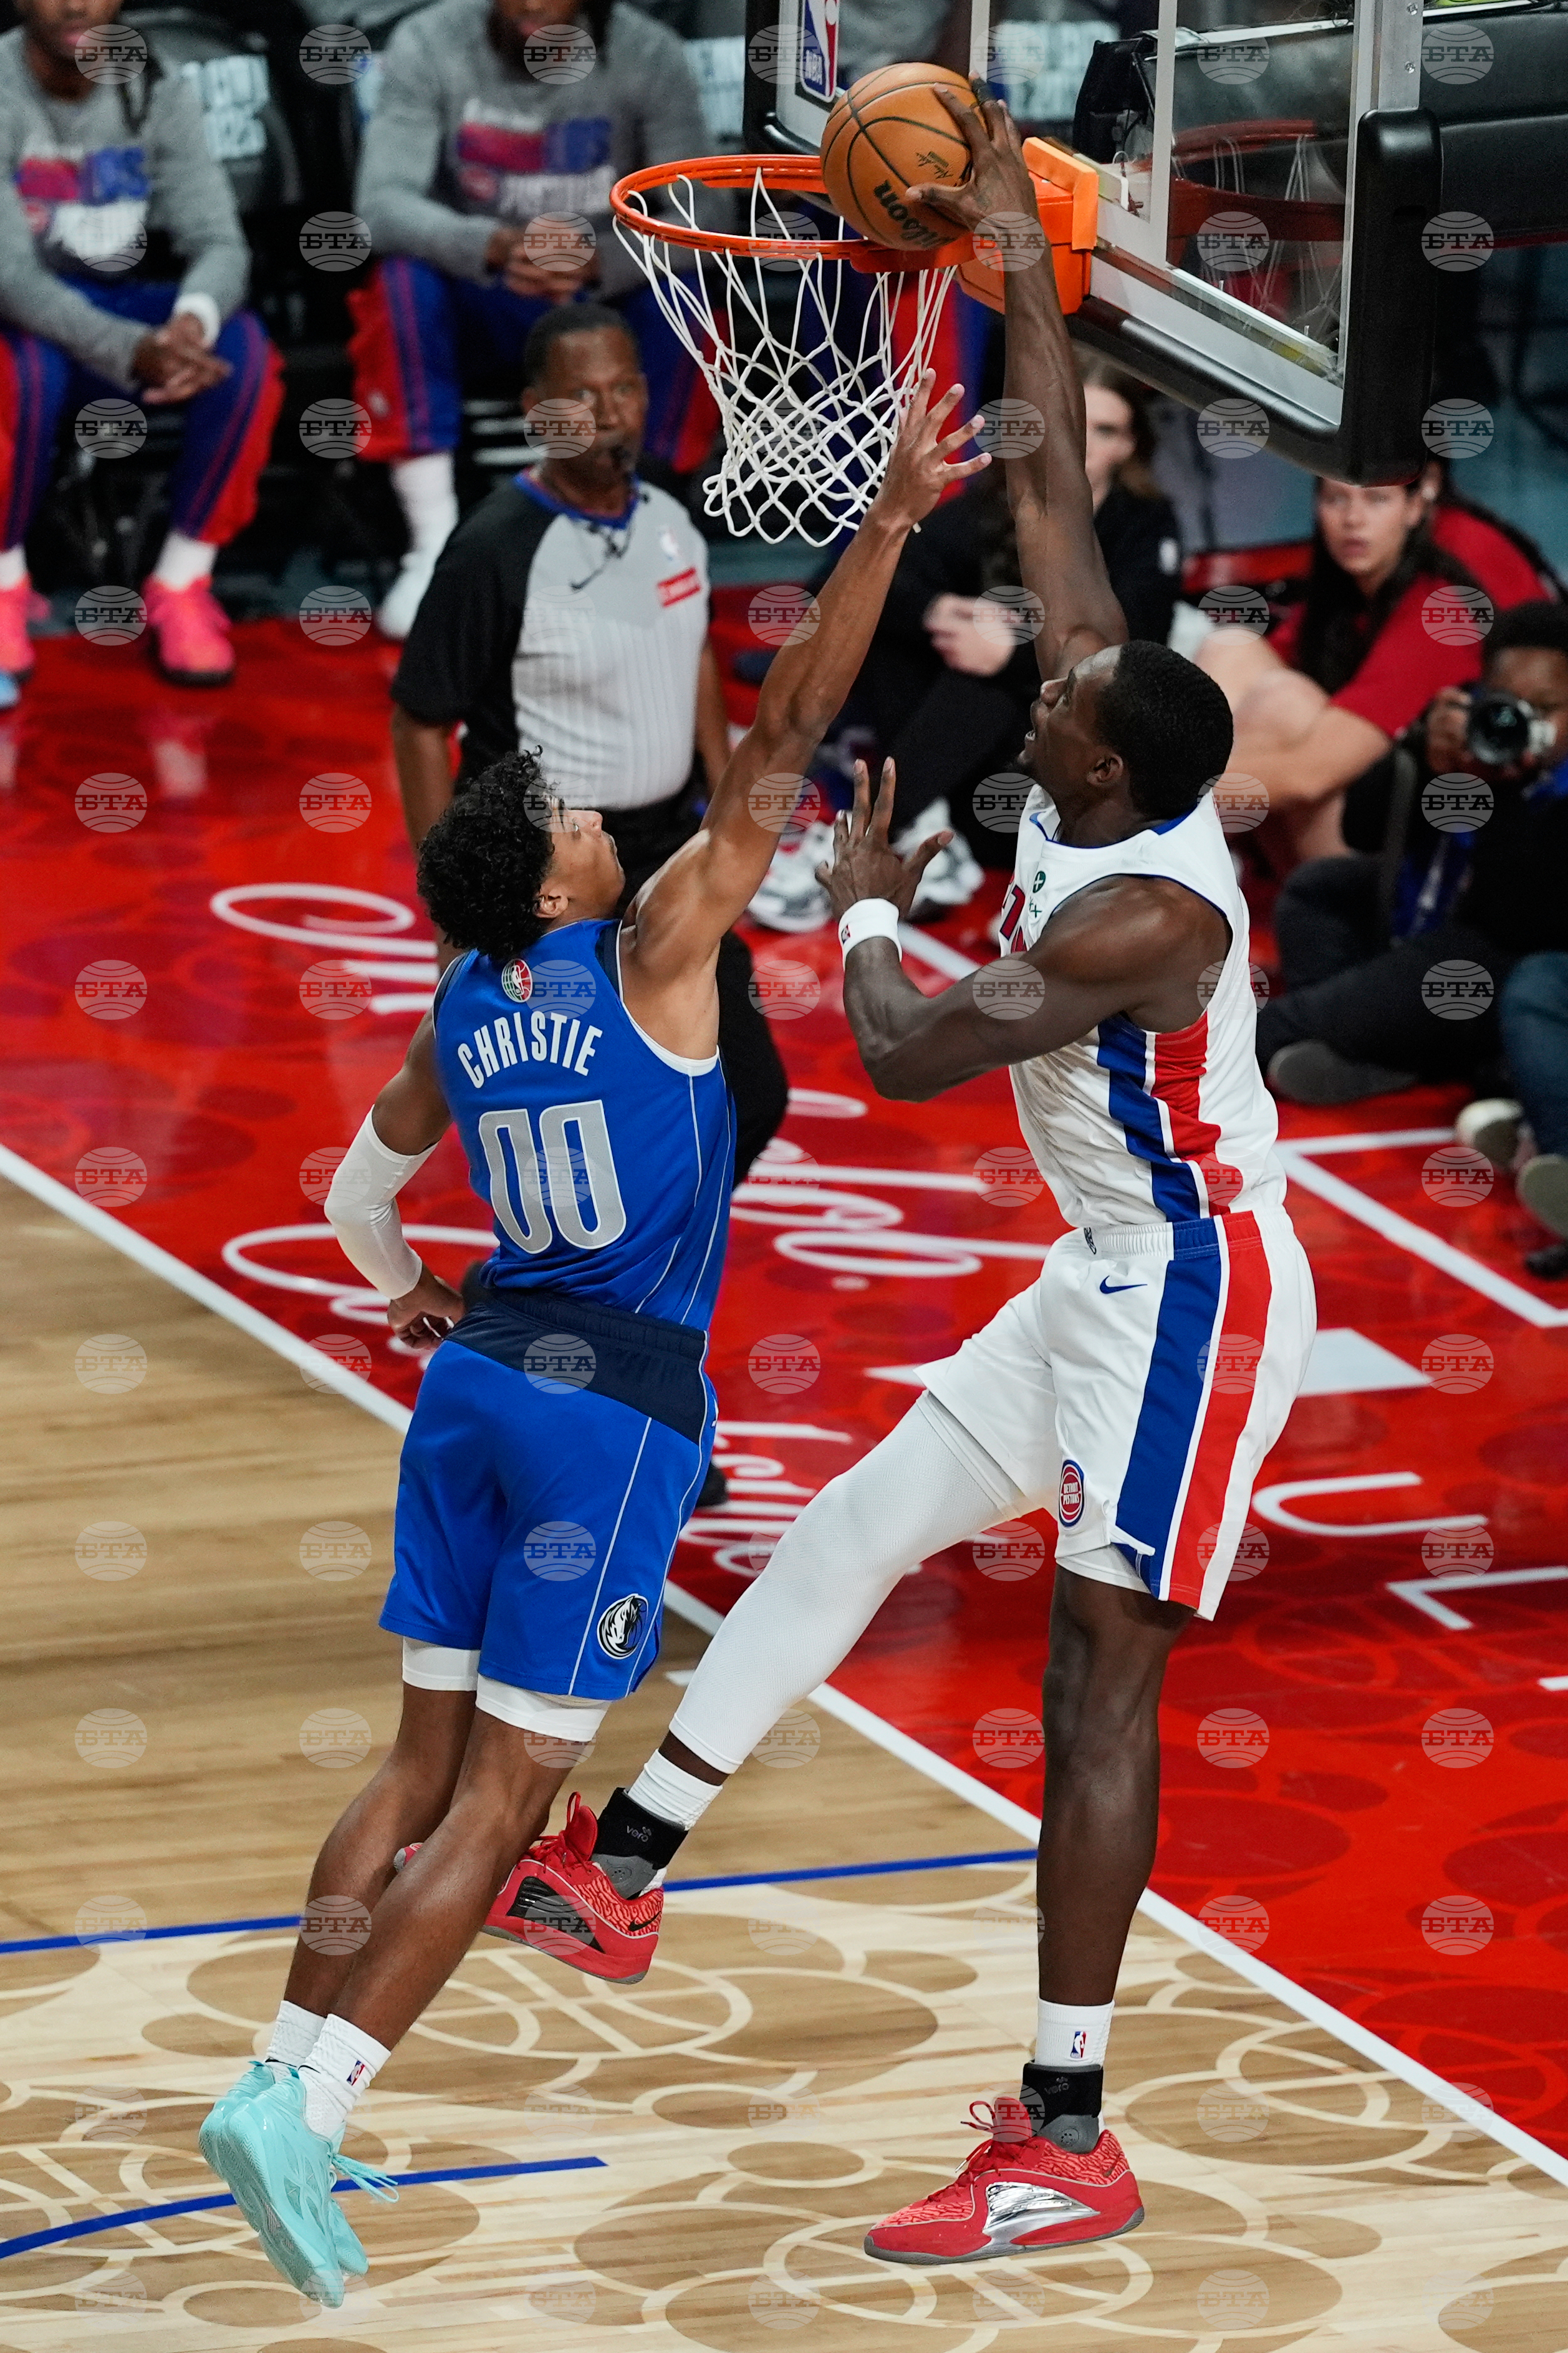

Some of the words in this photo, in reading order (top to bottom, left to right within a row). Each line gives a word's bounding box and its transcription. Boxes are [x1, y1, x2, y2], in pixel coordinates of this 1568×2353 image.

[873, 179, 953, 248] ilson
[458, 1010, 603, 1089] CHRISTIE
[479, 1099, 626, 1254] 00
